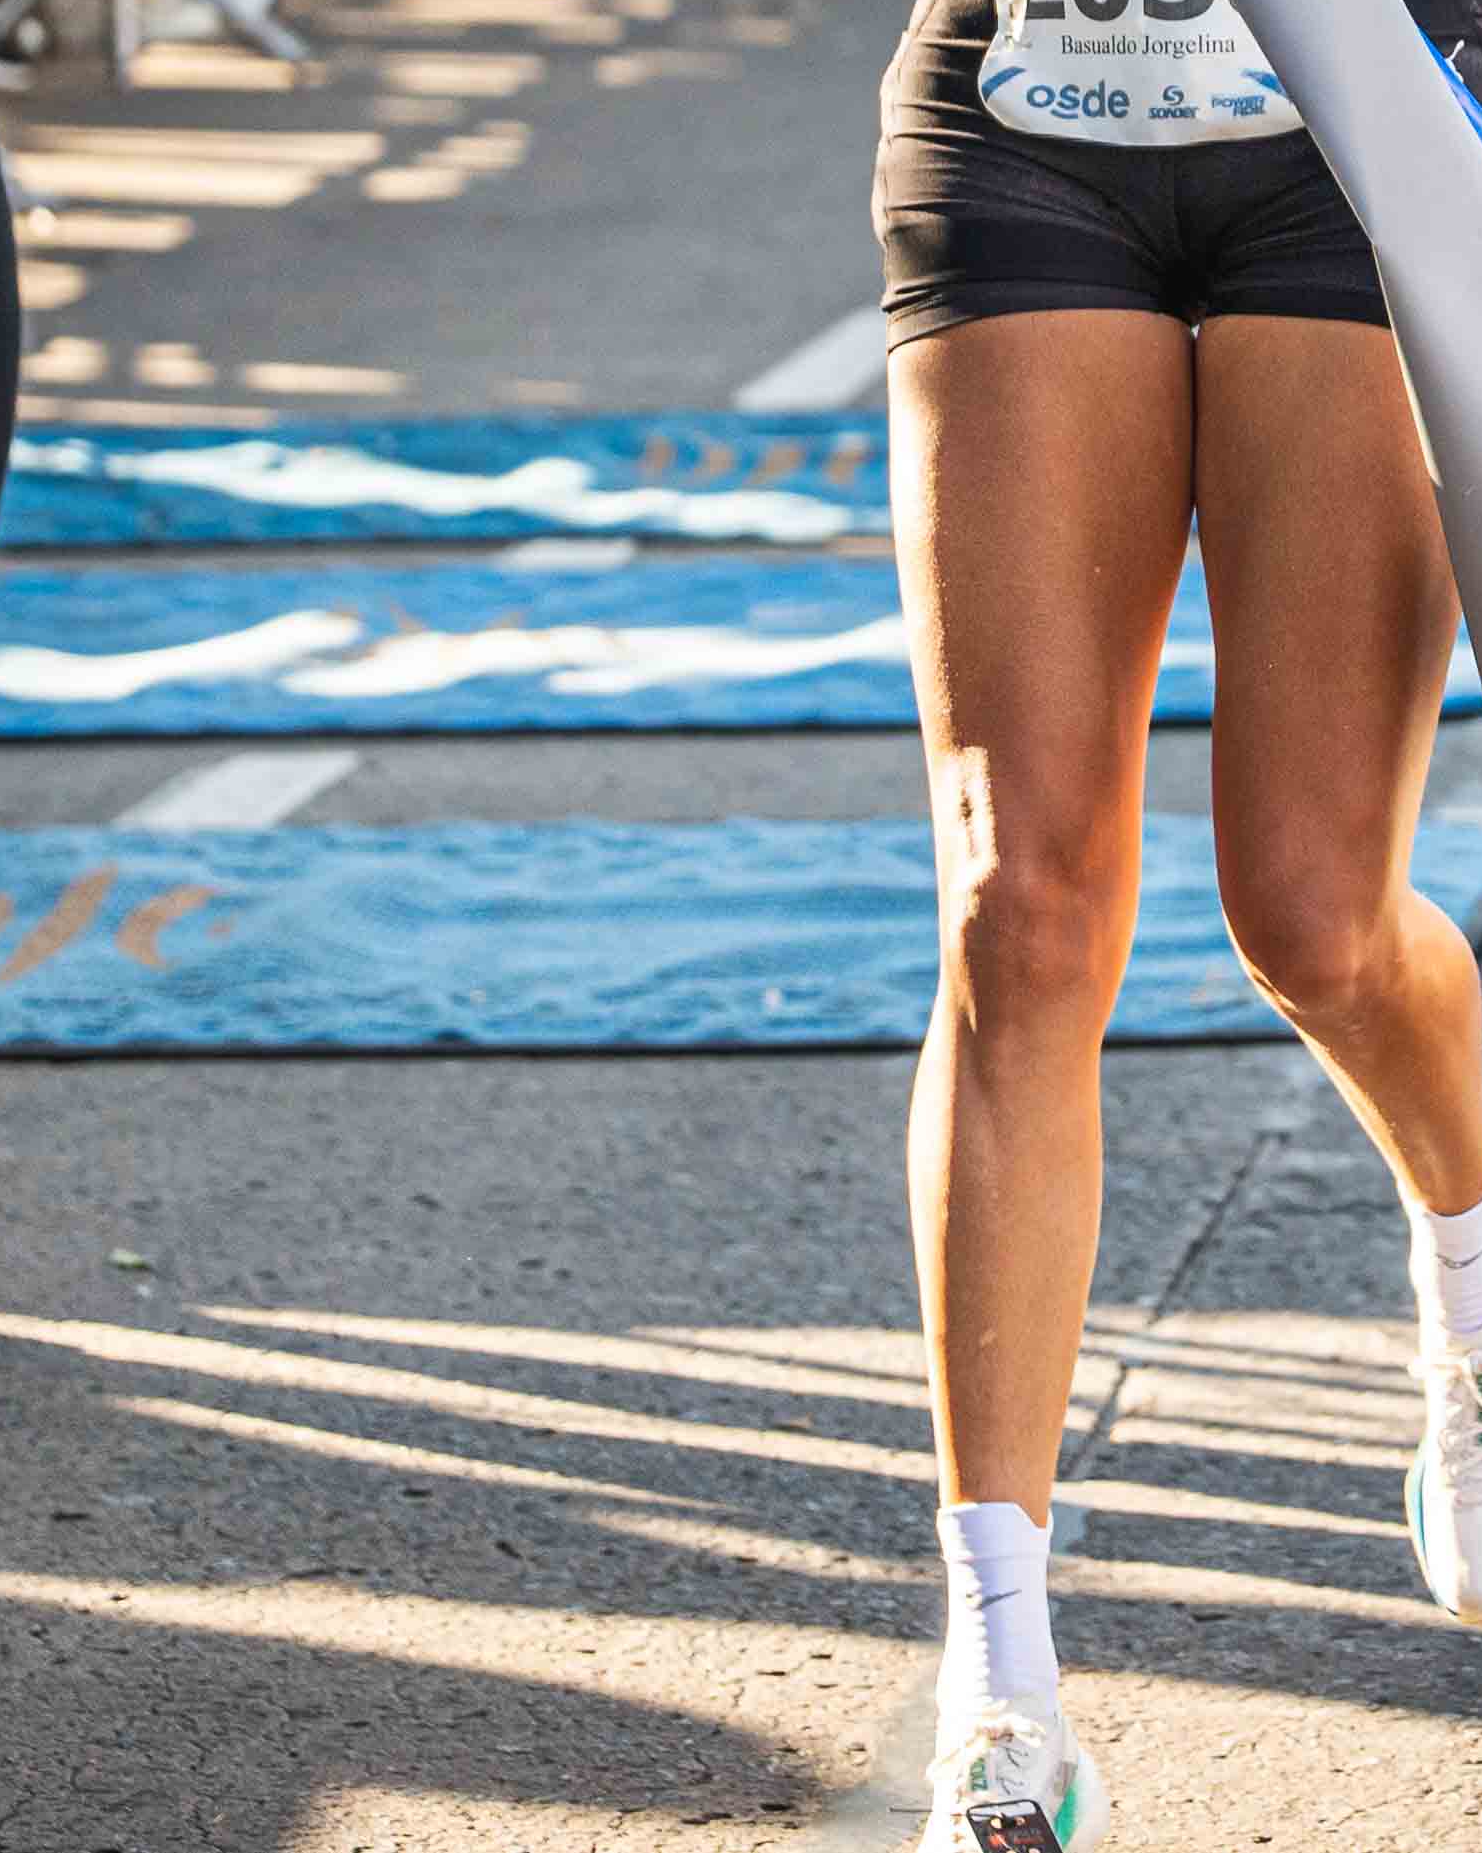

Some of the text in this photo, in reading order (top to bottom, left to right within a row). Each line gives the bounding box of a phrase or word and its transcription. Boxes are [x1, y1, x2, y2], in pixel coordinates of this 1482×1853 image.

[1061, 34, 1236, 59] Basualdo Jorgelina
[1025, 79, 1130, 119] osde
